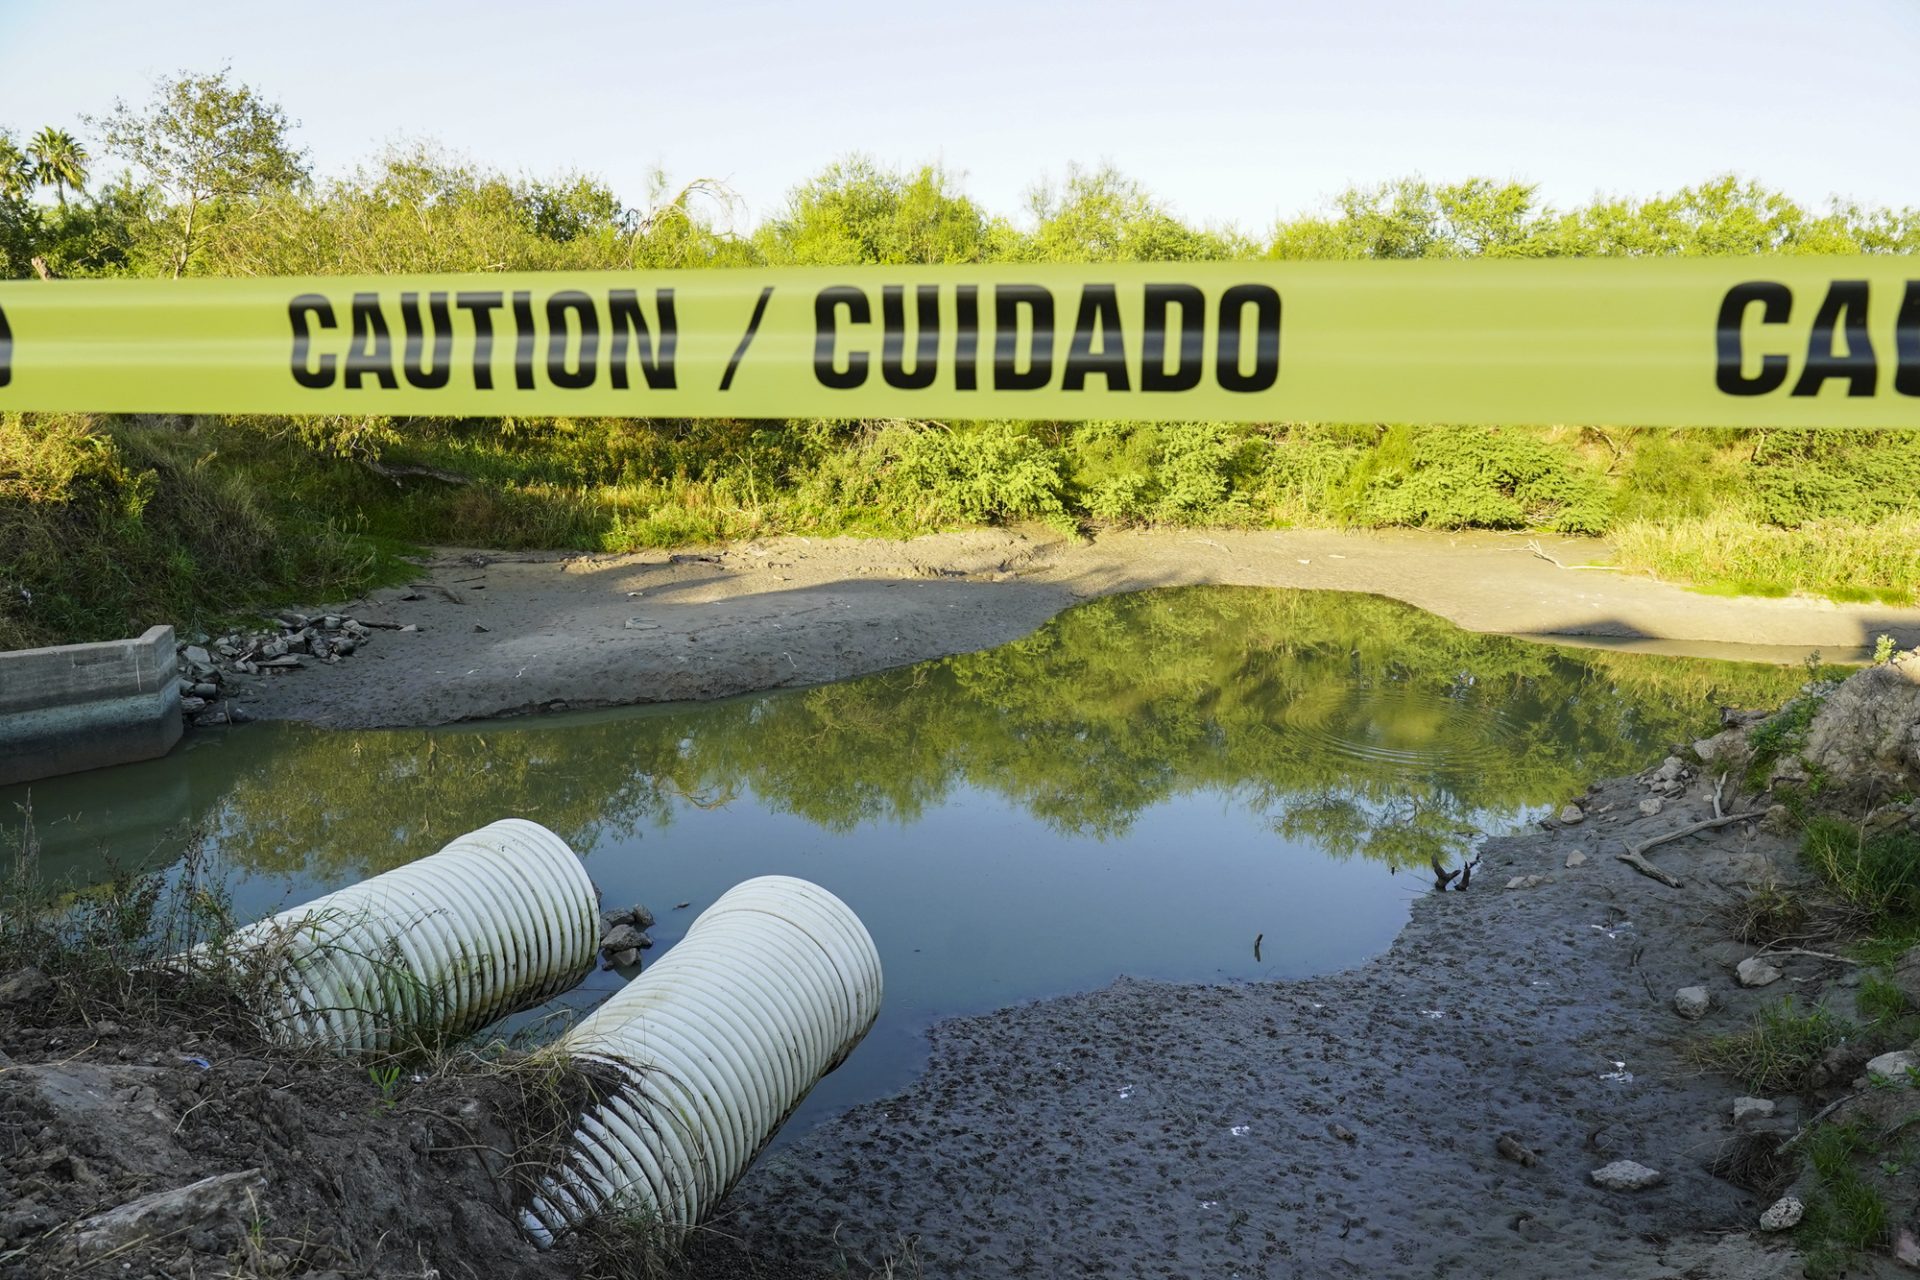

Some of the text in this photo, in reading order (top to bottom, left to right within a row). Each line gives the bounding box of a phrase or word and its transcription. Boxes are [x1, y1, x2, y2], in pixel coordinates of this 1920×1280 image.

[288, 288, 678, 391] CAUTION
[718, 286, 774, 392] /
[813, 283, 1283, 393] CUIDADO
